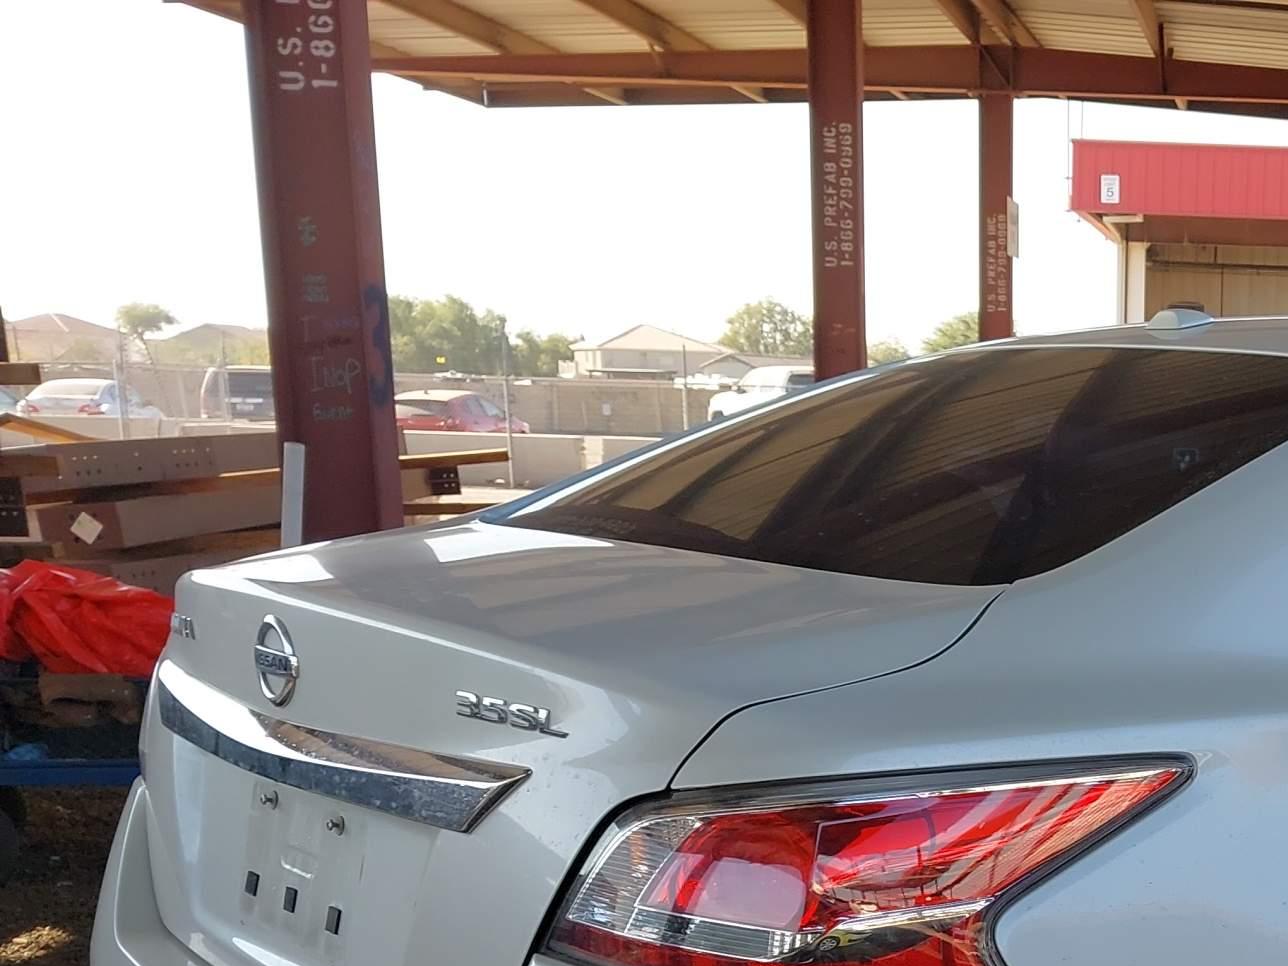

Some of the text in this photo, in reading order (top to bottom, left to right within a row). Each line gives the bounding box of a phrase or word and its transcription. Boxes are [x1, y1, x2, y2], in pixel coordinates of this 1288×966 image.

[276, 26, 305, 90] U.S.
[823, 121, 838, 267] U.S. PREFAB INC.
[1106, 187, 1114, 198] 5
